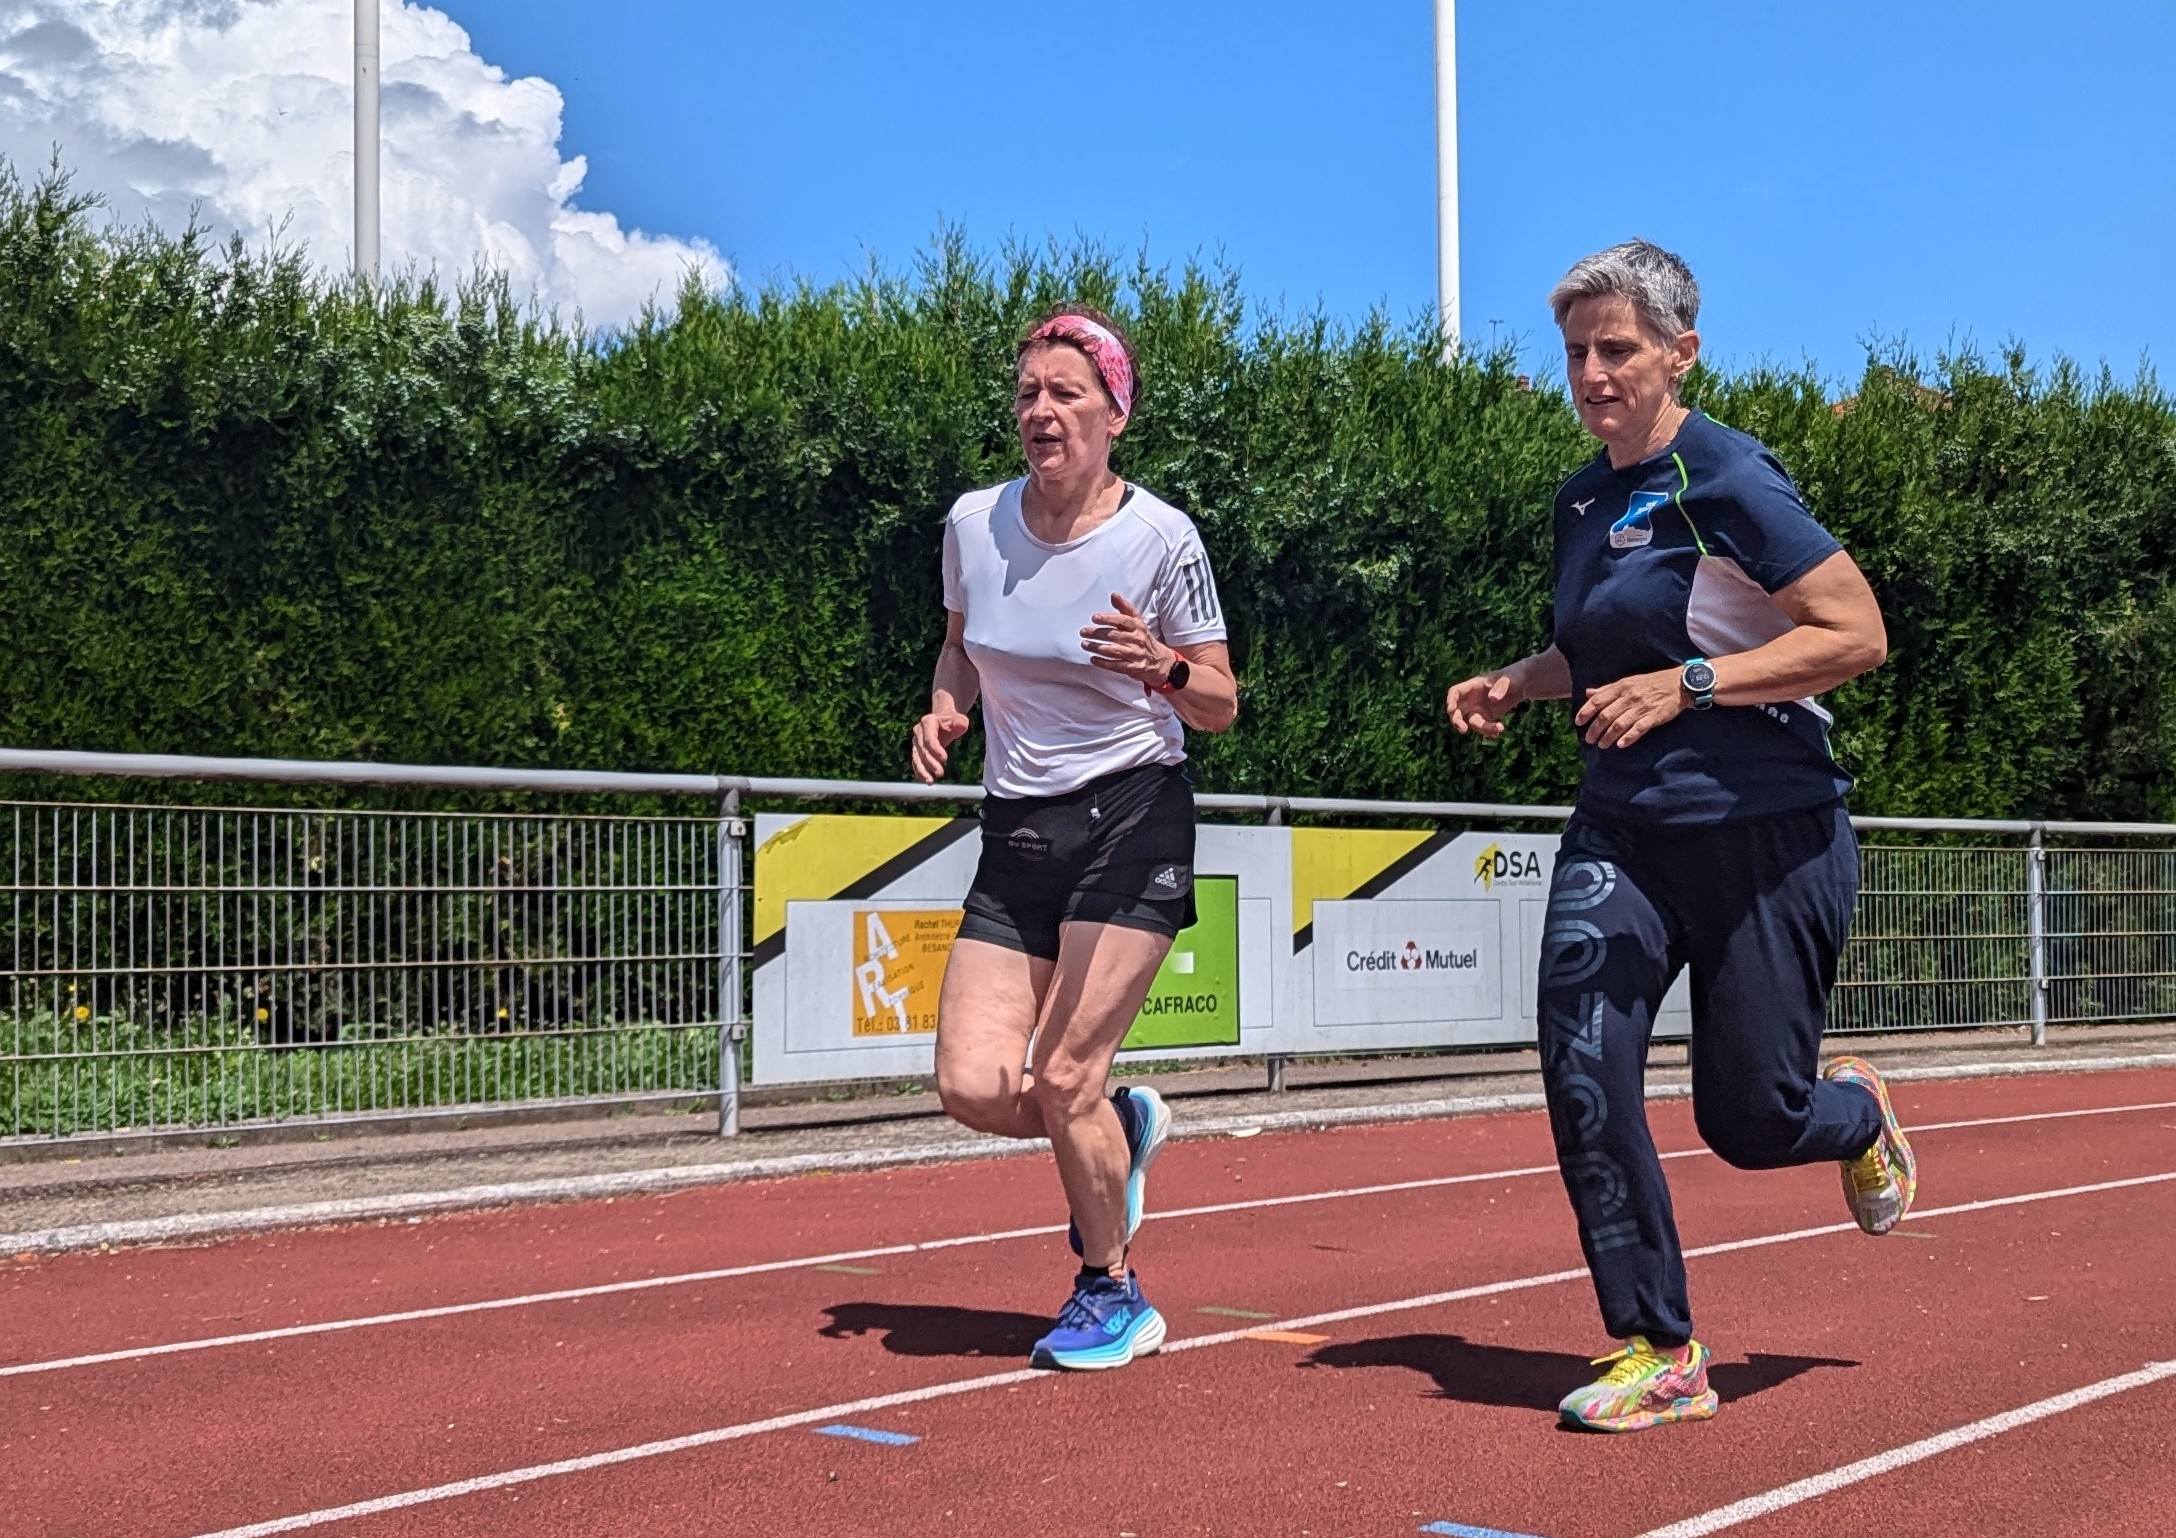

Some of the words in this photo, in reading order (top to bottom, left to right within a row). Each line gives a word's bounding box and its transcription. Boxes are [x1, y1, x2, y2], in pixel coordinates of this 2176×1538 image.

[1493, 850, 1541, 878] DSA
[914, 920, 939, 930] Rachel
[1346, 950, 1397, 972] Crédit
[1425, 949, 1477, 970] Mutuel
[1142, 994, 1217, 1016] CAFRACO
